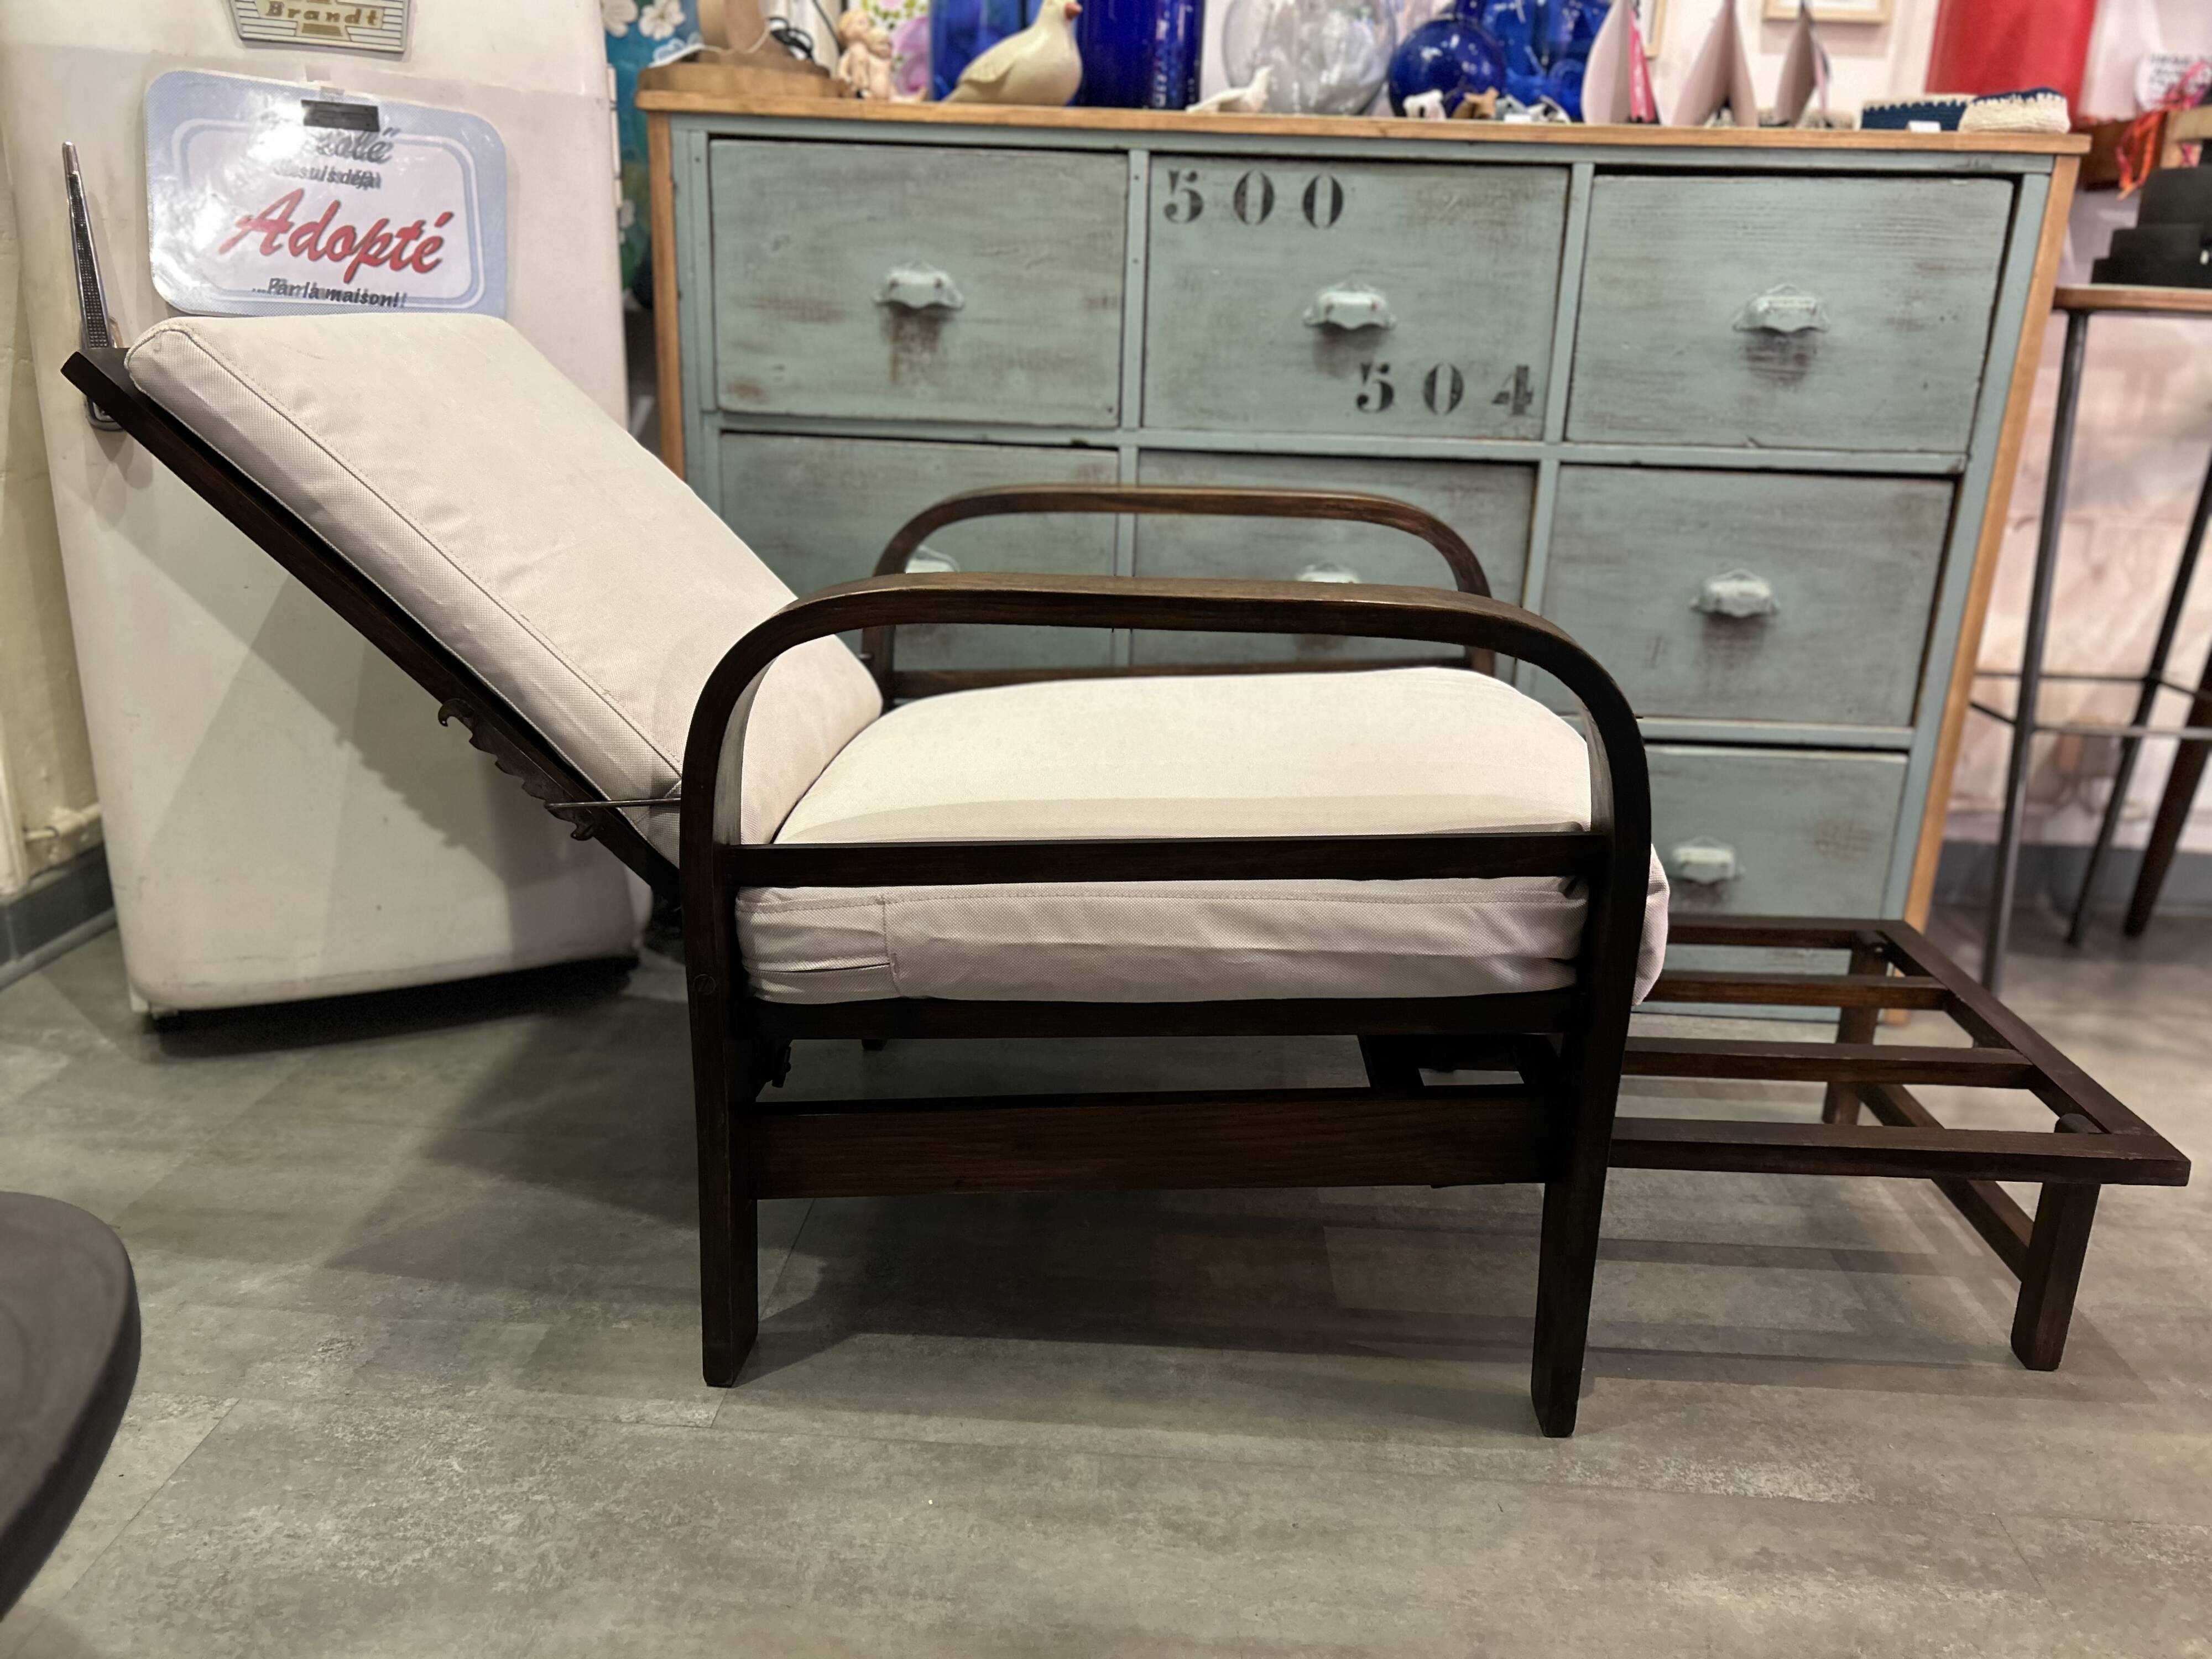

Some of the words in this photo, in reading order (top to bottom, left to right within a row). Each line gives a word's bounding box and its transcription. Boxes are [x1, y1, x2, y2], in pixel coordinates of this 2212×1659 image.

[266, 1, 378, 26] Brandt
[1164, 169, 1344, 229] 500
[219, 188, 454, 284] Adopté
[1357, 362, 1533, 416] 504
